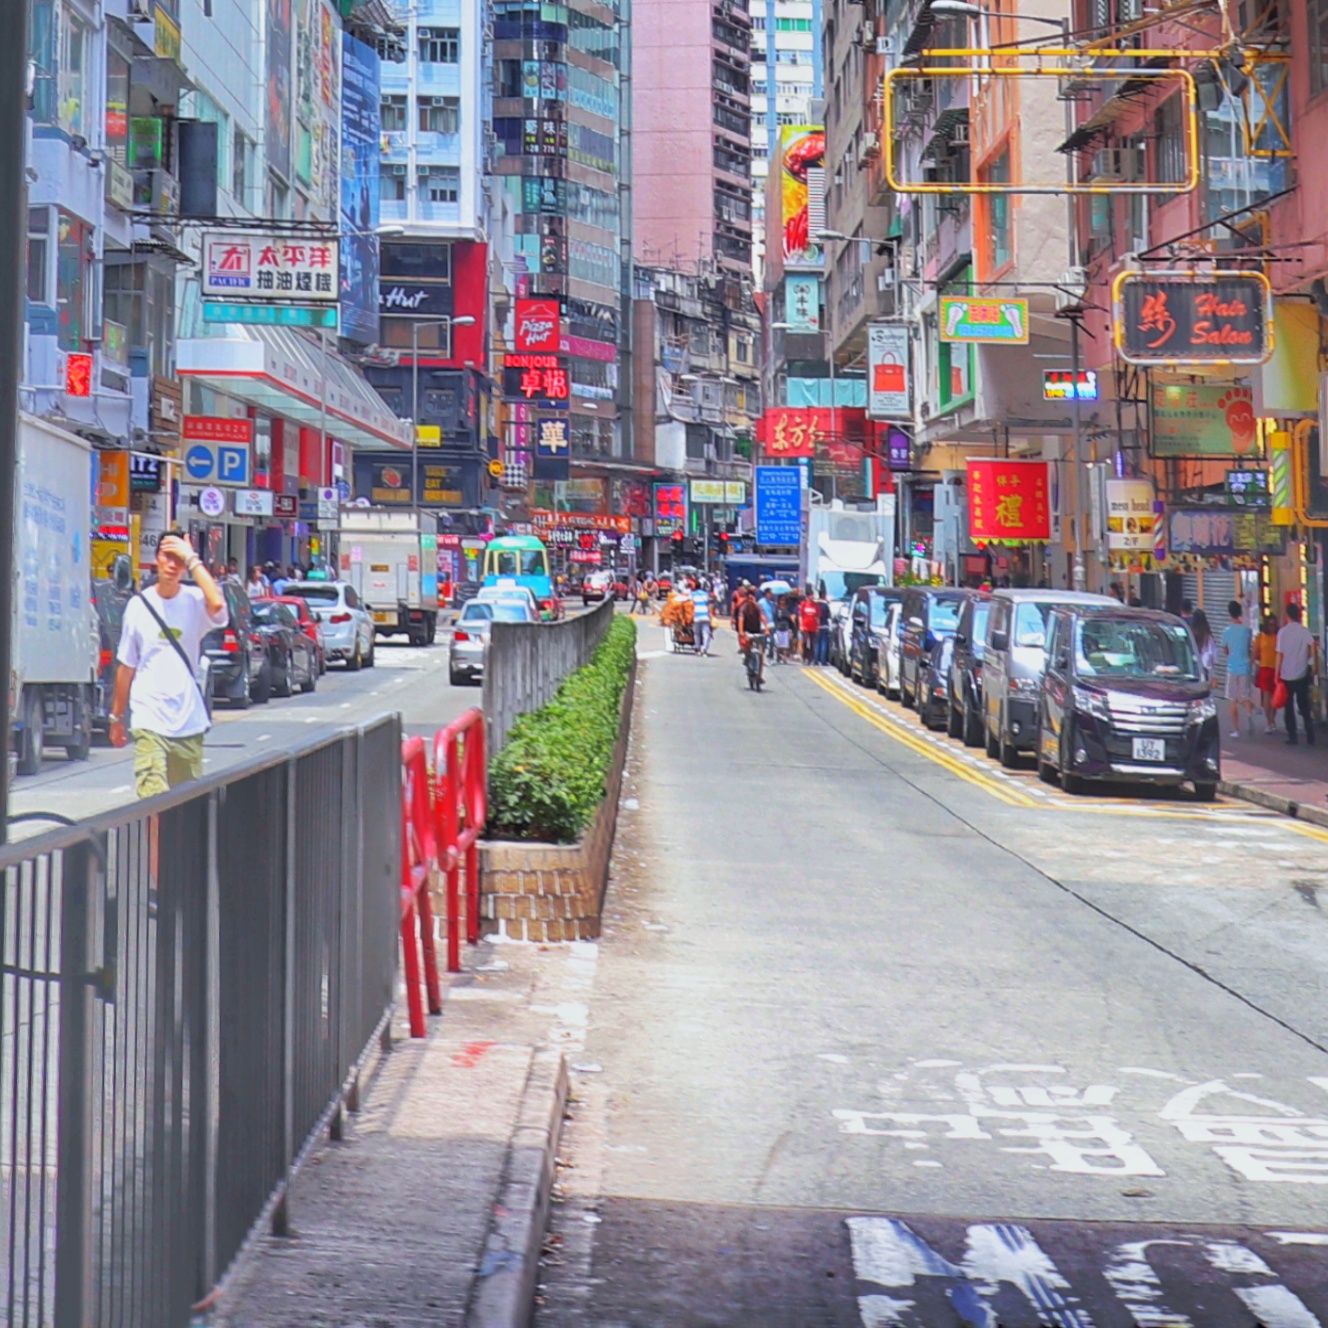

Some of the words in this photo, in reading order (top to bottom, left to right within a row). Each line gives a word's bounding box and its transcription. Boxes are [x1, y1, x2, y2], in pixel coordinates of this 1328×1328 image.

[257, 245, 332, 269] 太平洋
[256, 269, 333, 293] 抽油煙機
[387, 286, 429, 308] Hut
[1193, 291, 1247, 318] Hair
[519, 317, 554, 337] Pizza
[524, 330, 553, 346] Hut
[1190, 319, 1253, 346] Salon
[504, 354, 560, 368] BONJOUR
[520, 369, 570, 399] 卓悅
[223, 451, 241, 477] P
